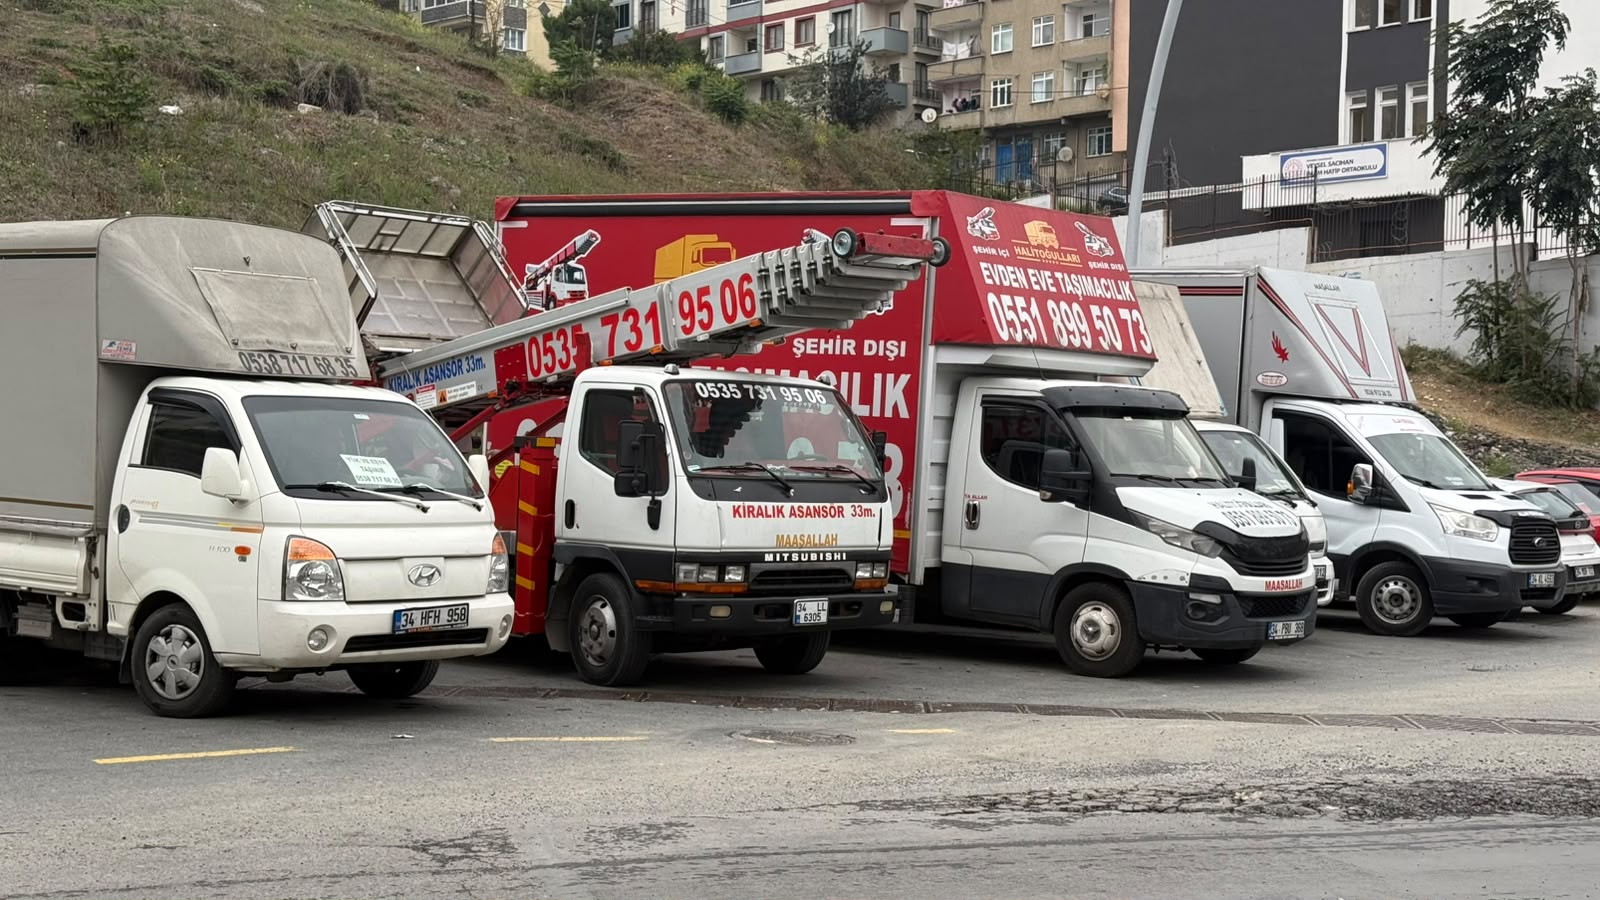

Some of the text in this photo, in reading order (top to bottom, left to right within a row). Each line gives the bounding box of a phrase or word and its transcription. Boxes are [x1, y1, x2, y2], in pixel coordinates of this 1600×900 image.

[1323, 167, 1341, 175] HATİP
[1341, 164, 1378, 173] ORTAOKULU
[972, 245, 1010, 258] ŞEHİR İÇİ
[1013, 245, 1081, 264] HALİTOĞULLARI
[1088, 261, 1125, 272] ŞEHİR DIŞI
[979, 262, 1136, 302] EVDEN EVE TAŞIMACILIK
[601, 301, 662, 363] 731
[678, 285, 714, 336] 95
[720, 272, 756, 325] 06
[987, 292, 1152, 354] 0551 899 50 73
[792, 335, 906, 361] ŞEHİR DIŞI
[238, 351, 359, 377] 0538 717 68 35
[424, 358, 464, 385] ASANSÖR
[465, 355, 486, 374] 33m.
[694, 382, 827, 405] 0535 731 95 06
[732, 502, 876, 519] KİRALIK ASANSÖR 33m.
[764, 552, 847, 562] MITSUBISHI
[401, 607, 467, 628] 34 HFH 958
[797, 602, 826, 613] 34 LL
[803, 612, 821, 622] 6305
